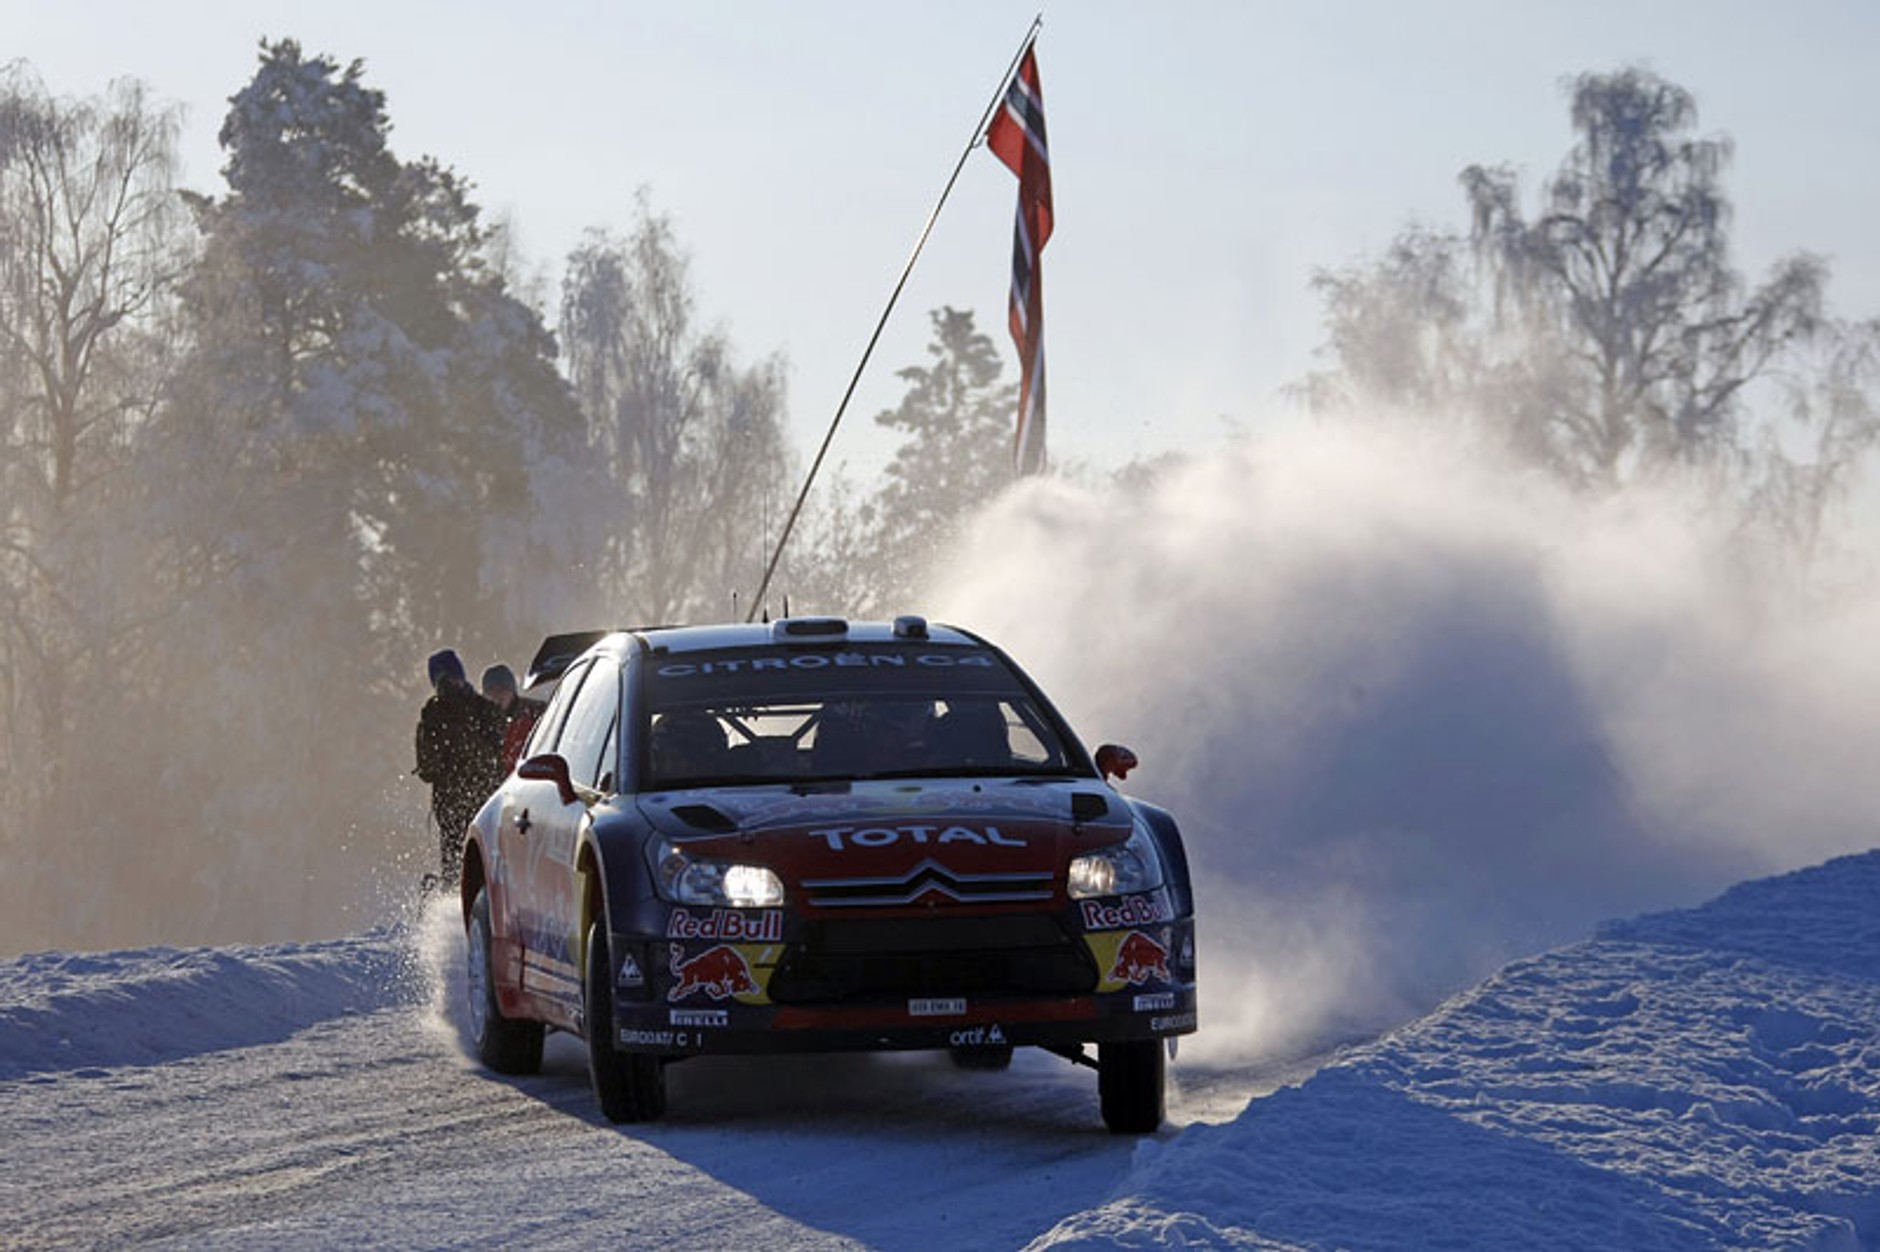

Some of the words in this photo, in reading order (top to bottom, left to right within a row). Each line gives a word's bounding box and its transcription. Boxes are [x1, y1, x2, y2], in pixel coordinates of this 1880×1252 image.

[657, 651, 905, 677] CITROËN
[916, 653, 994, 668] C4
[809, 826, 1028, 850] TOTAL
[666, 908, 721, 938] Red
[719, 909, 783, 940] Bull
[1080, 895, 1135, 929] Red
